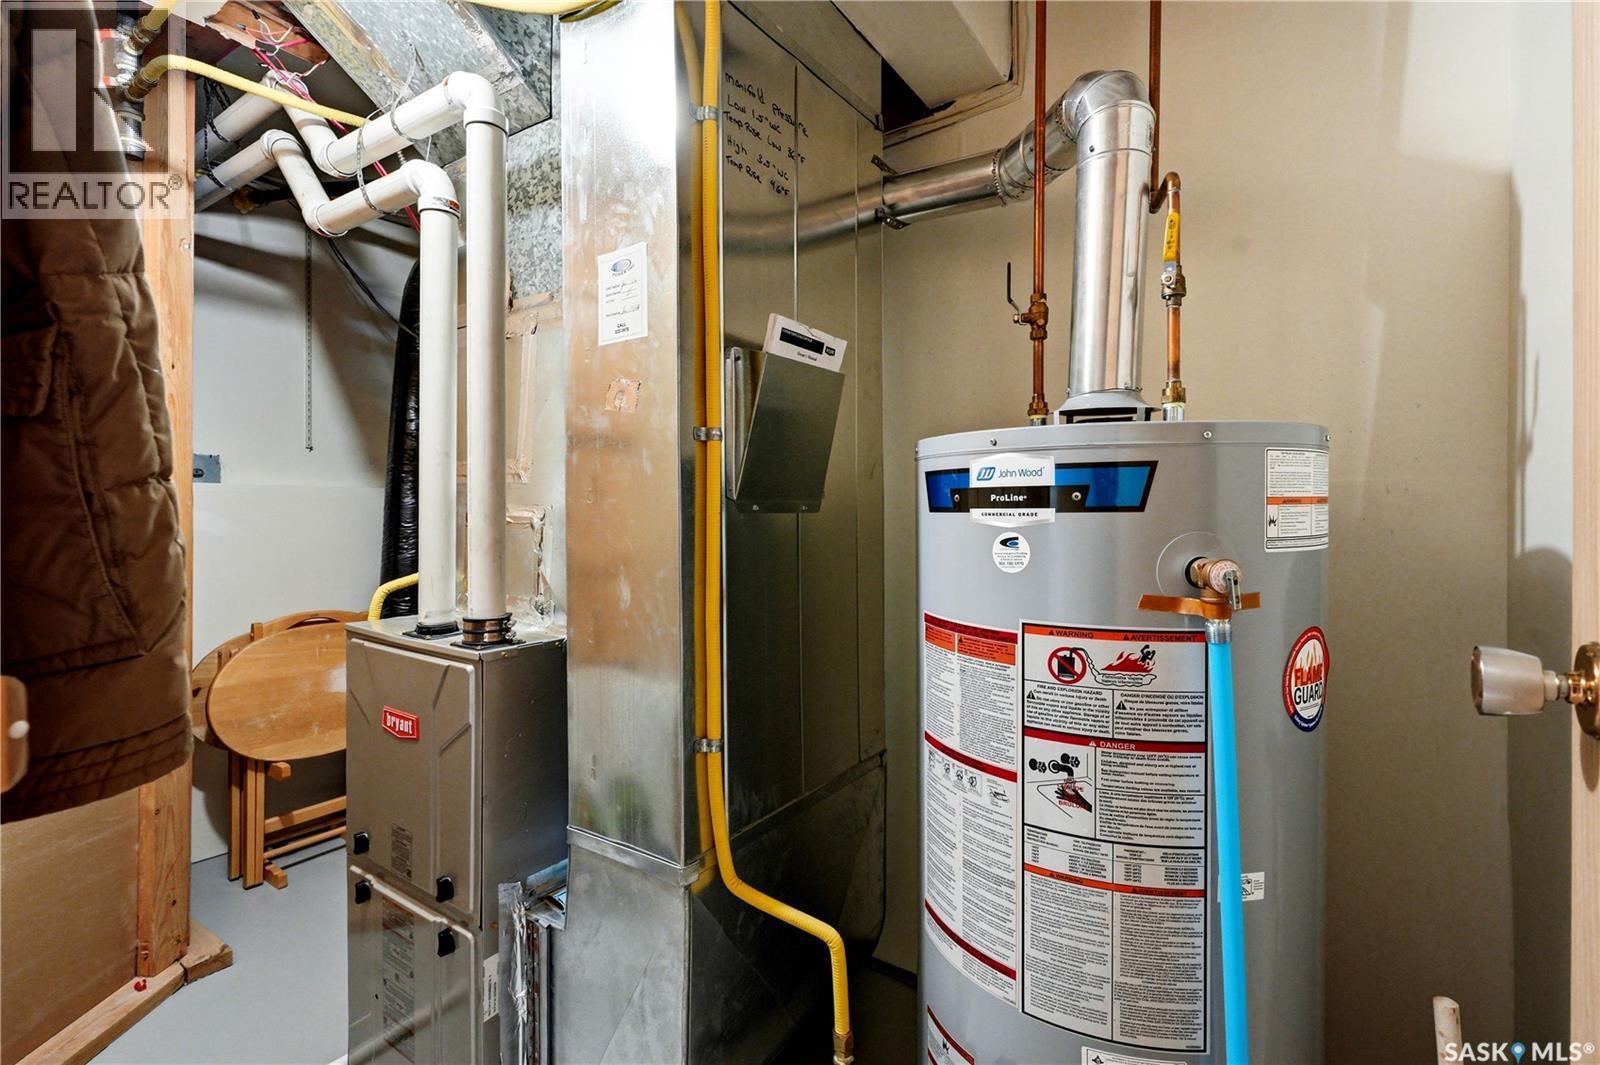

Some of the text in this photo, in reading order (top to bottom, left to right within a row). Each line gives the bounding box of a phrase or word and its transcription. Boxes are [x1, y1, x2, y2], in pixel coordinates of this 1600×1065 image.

[728, 94, 745, 113] Low
[724, 112, 743, 129] Temp
[745, 122, 761, 140] Rise
[772, 103, 808, 138] Pressure
[728, 136, 747, 155] High
[726, 156, 743, 172] Temp
[998, 468, 1016, 478] John
[1056, 631, 1094, 639] WARNING
[1295, 663, 1322, 687] FLAME
[386, 713, 412, 734] bryant
[1100, 741, 1136, 750] DANGER
